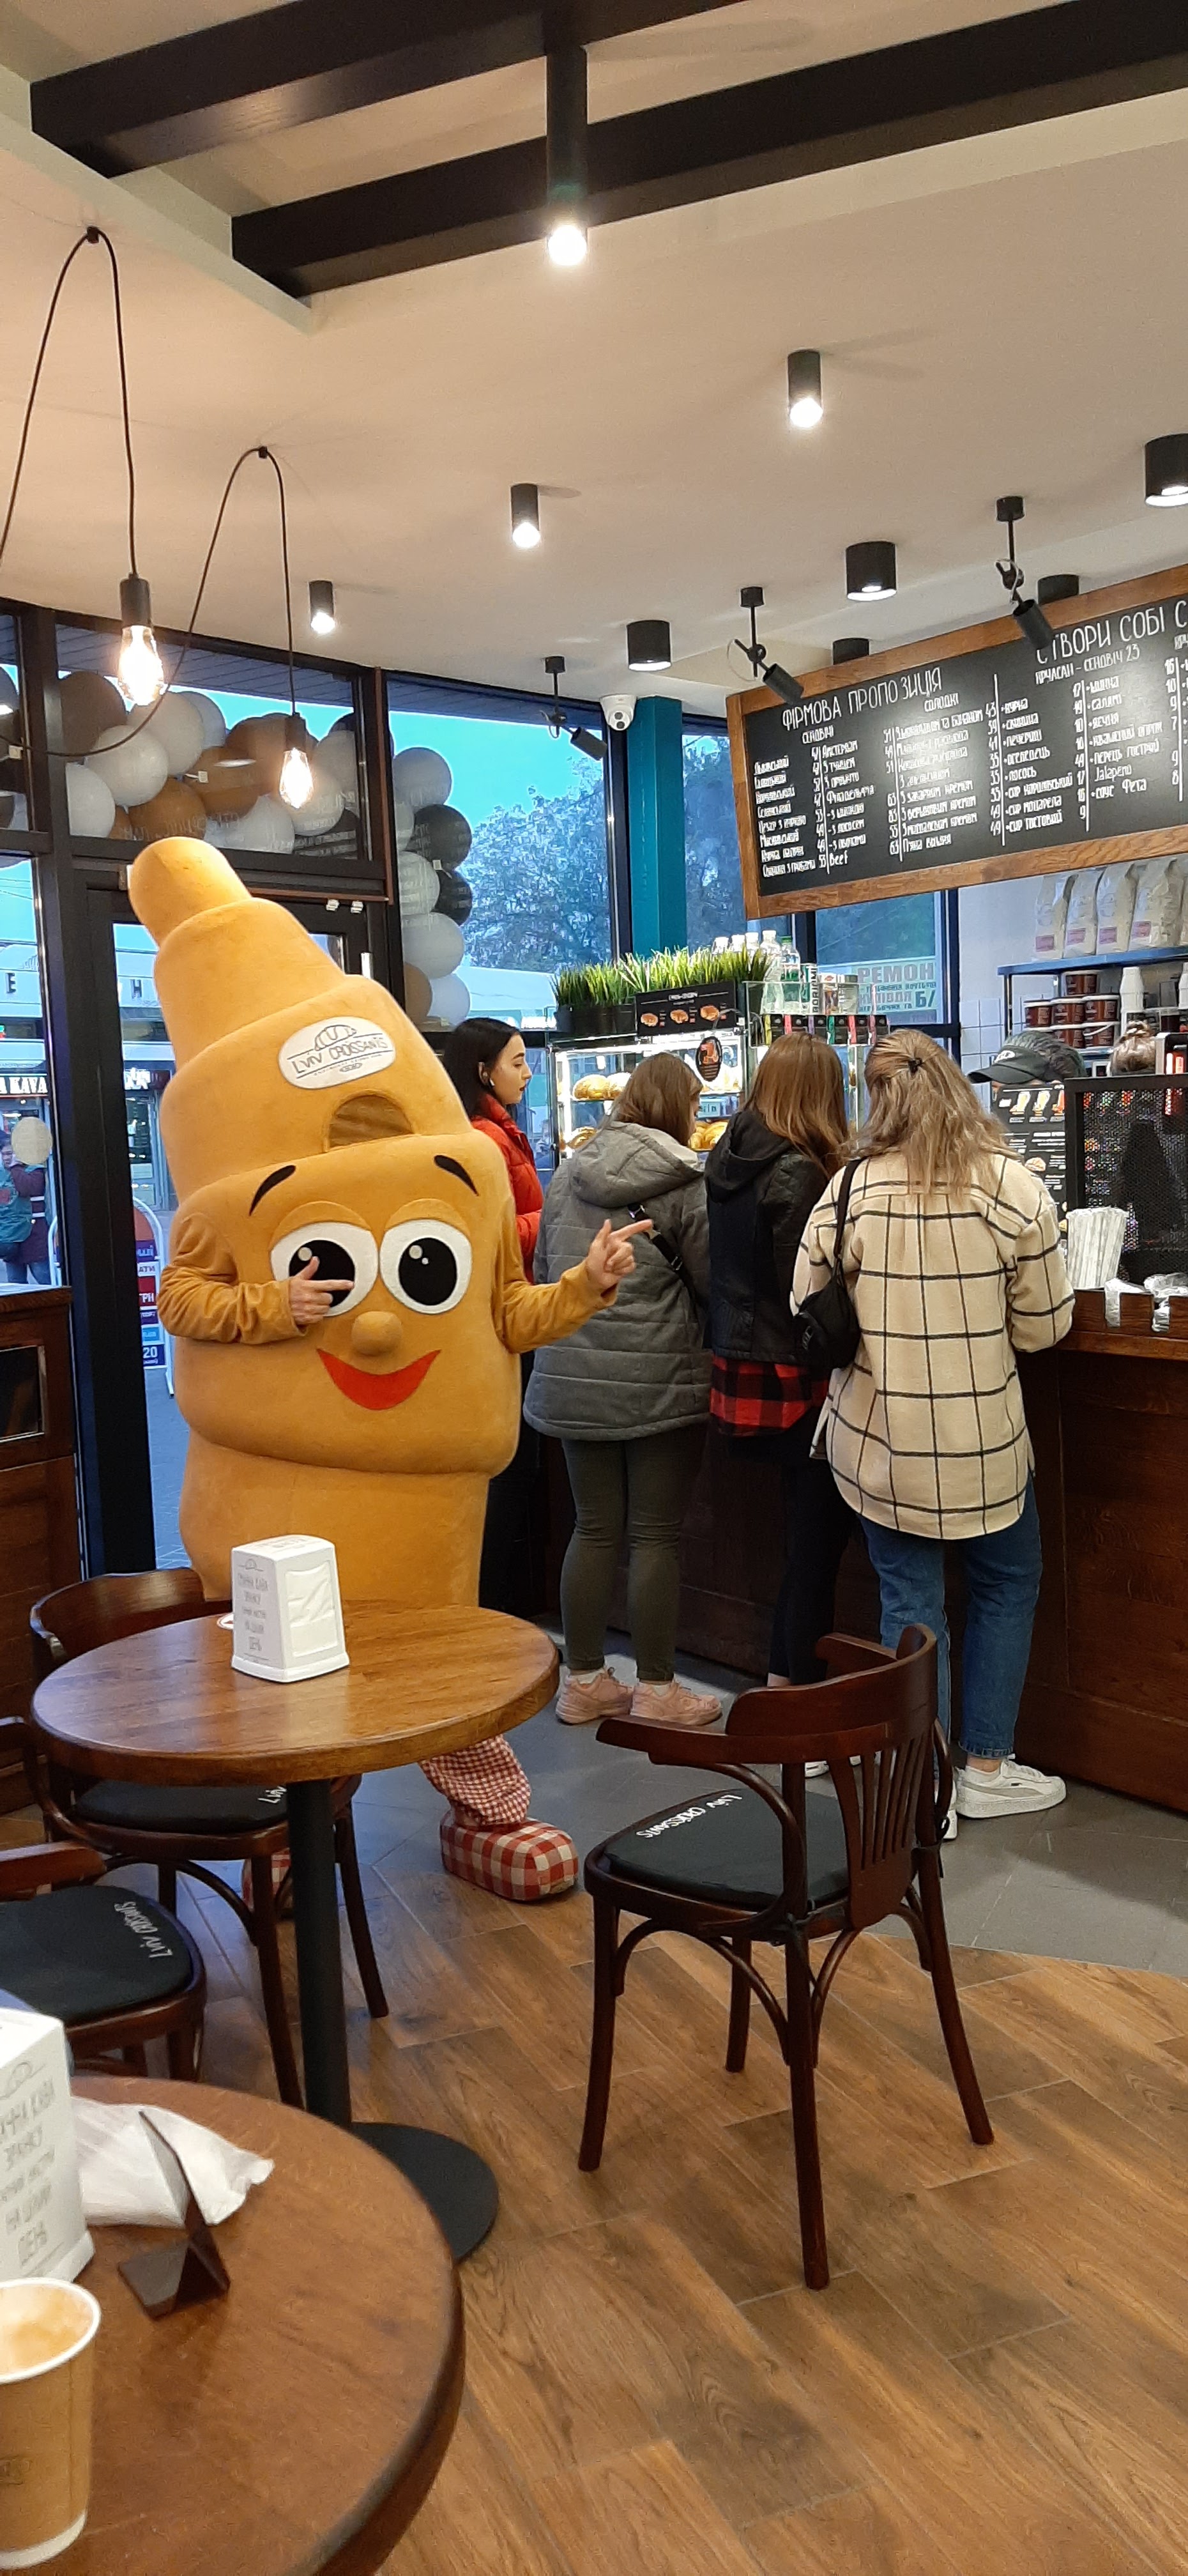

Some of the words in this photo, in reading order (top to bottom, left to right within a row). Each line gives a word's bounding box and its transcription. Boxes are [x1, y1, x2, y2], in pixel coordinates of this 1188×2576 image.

[1120, 606, 1165, 642] СОБІ
[1126, 643, 1140, 662] 23
[985, 702, 997, 717] 43
[1170, 695, 1177, 711] 9
[782, 696, 842, 731] ФІРМОВА
[1170, 716, 1178, 731] 7
[1171, 750, 1179, 767] 9
[830, 850, 848, 866] Beef
[857, 962, 934, 984] РЕМОН
[142, 1346, 158, 1359] 20
